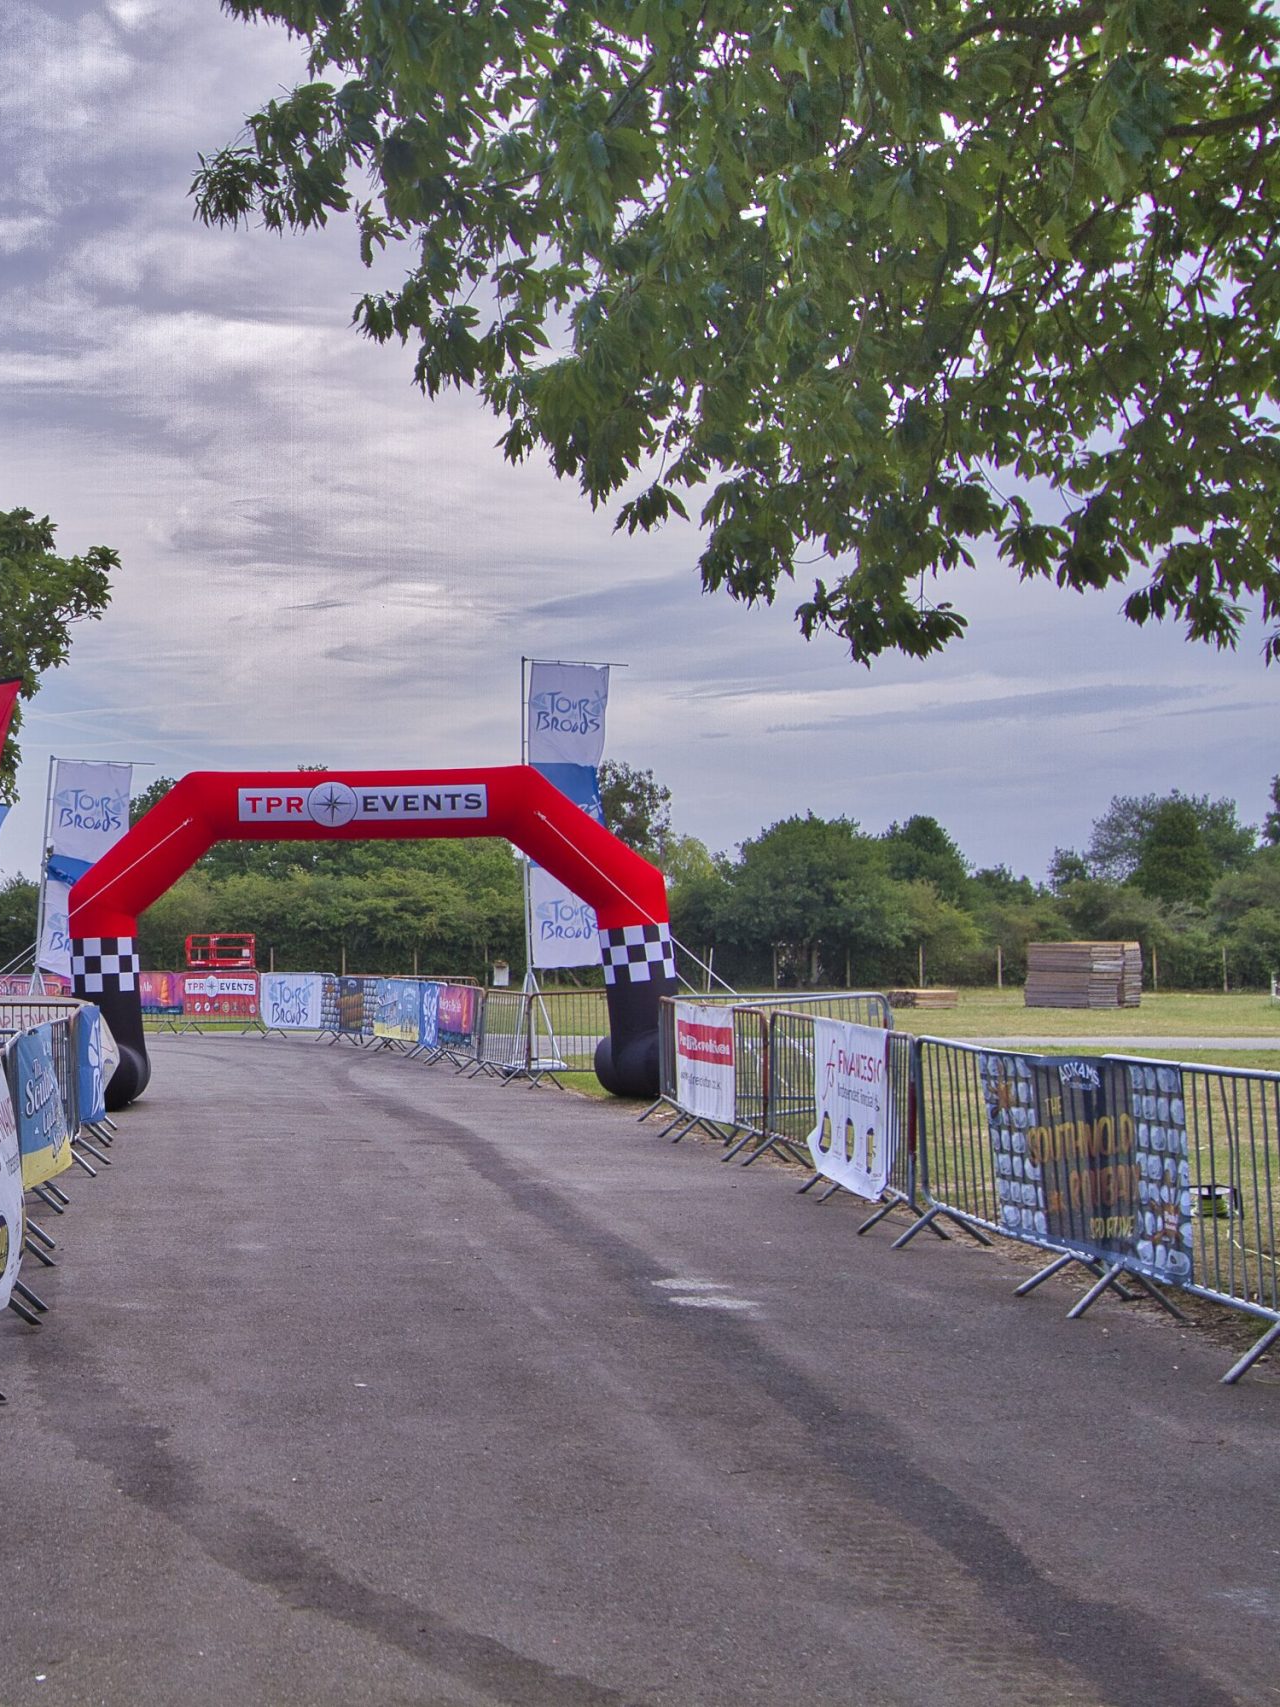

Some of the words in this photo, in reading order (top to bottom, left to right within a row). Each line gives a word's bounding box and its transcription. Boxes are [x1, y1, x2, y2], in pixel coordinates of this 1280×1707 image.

[245, 796, 304, 814] TPR
[362, 793, 482, 813] EVENTS
[187, 982, 205, 991] TPR
[220, 982, 255, 992] EVENTS
[1045, 1095, 1062, 1117] THE
